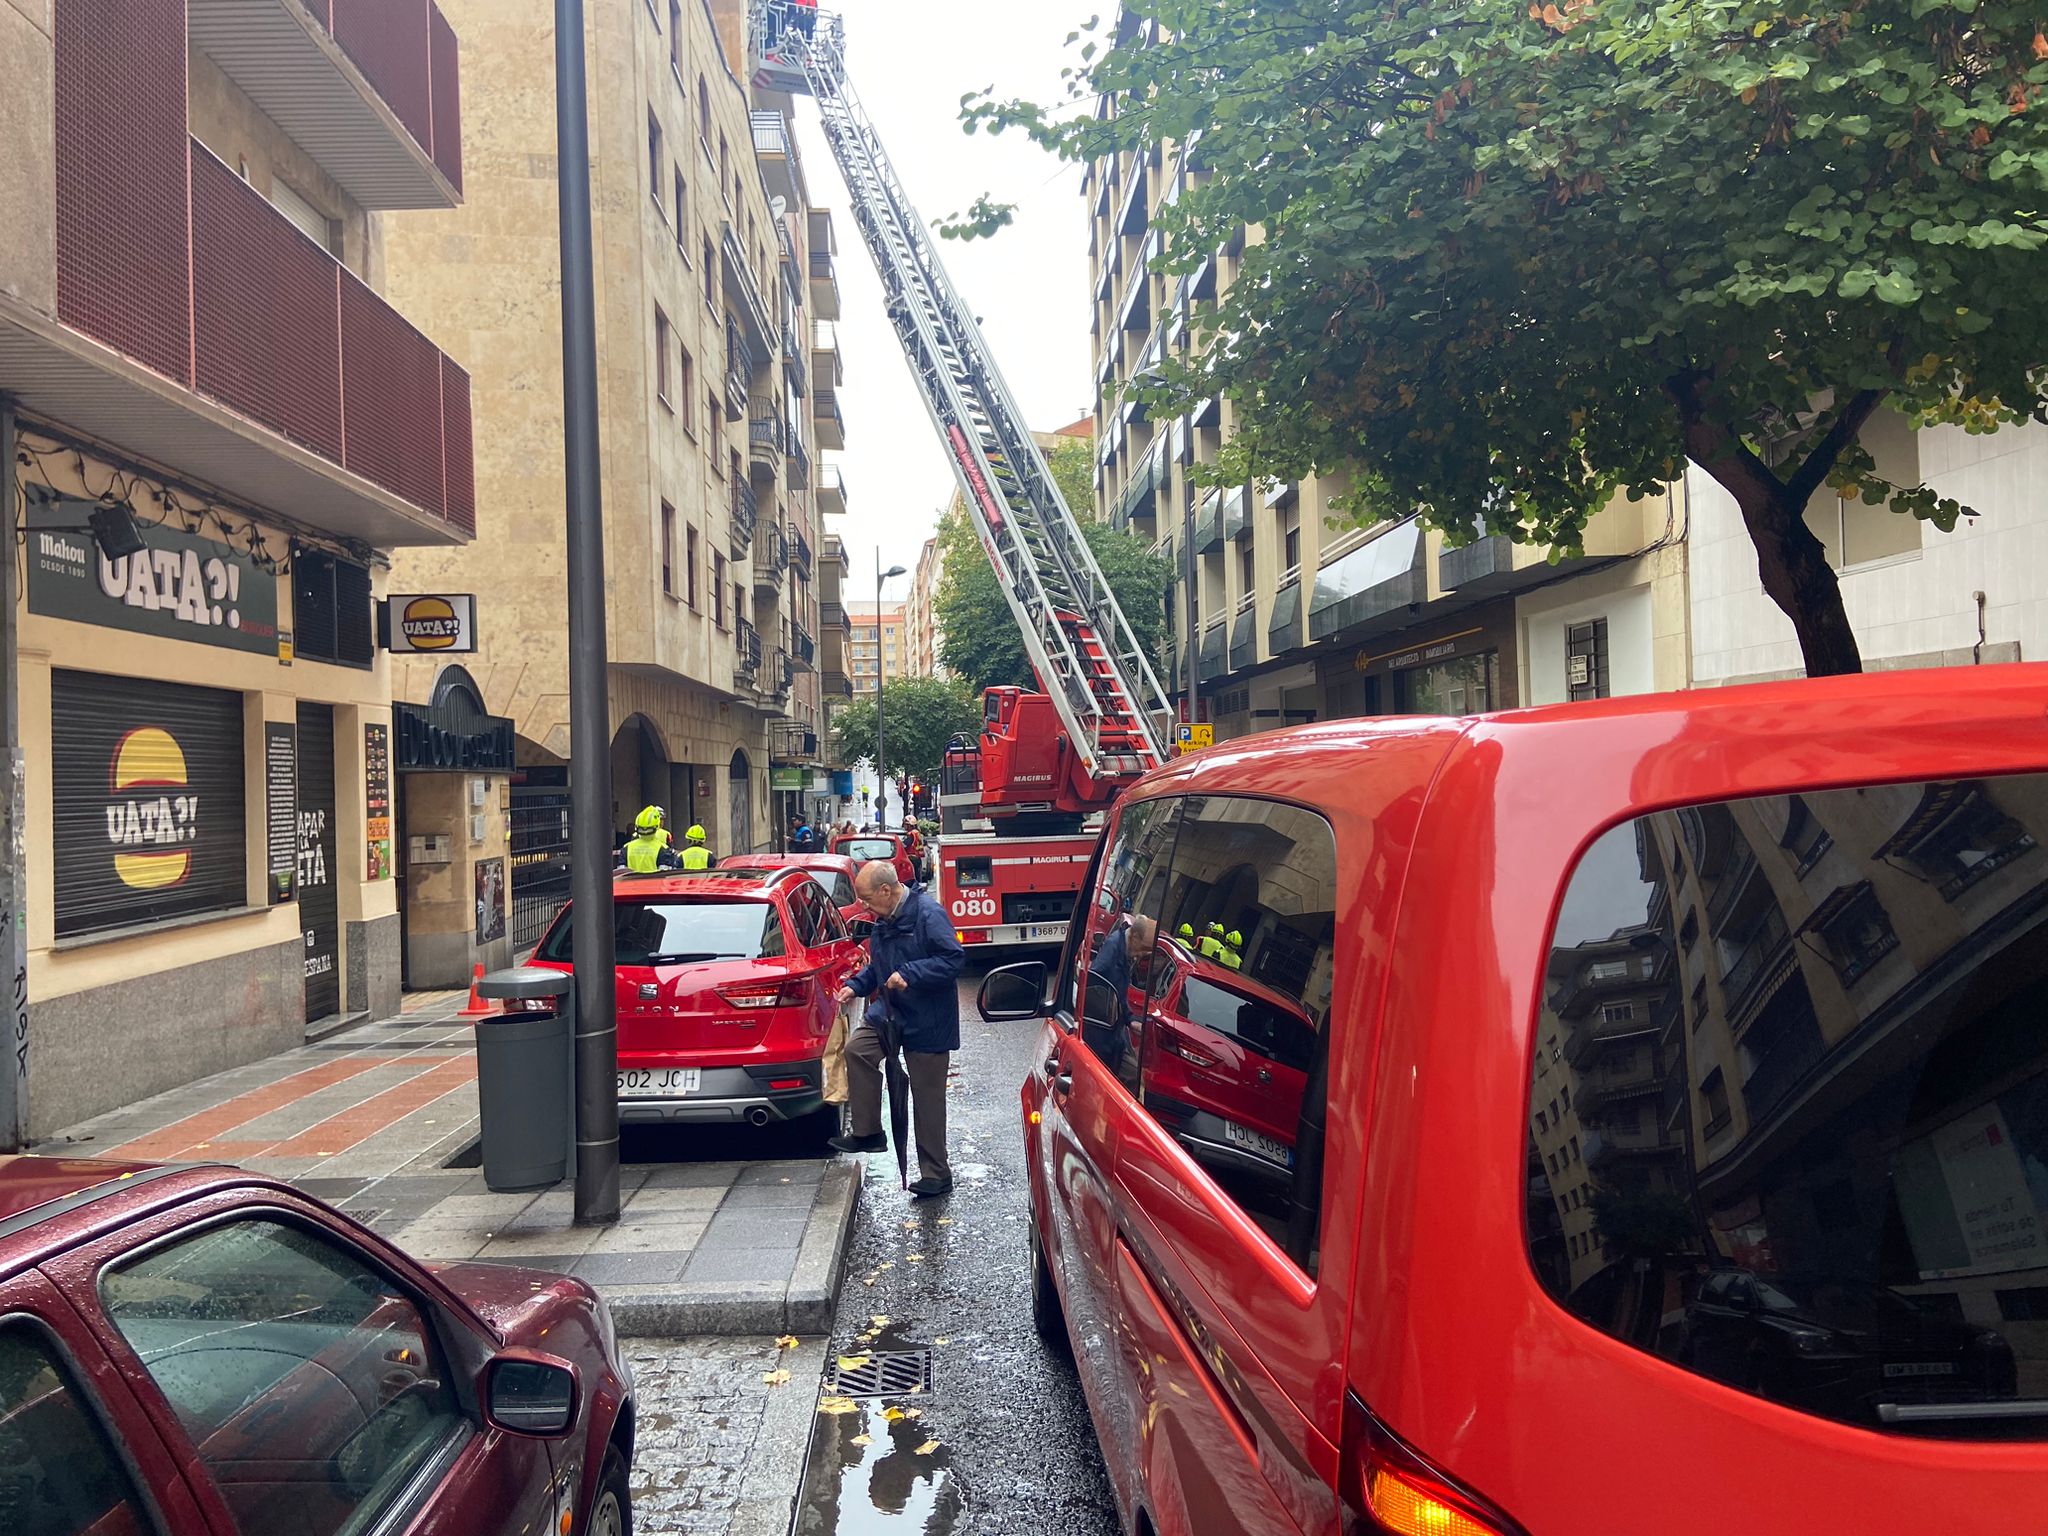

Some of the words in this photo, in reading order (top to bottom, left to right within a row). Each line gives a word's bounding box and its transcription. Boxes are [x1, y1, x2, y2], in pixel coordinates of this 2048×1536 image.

[40, 533, 86, 564] Mahou
[41, 560, 65, 574] DESDE
[984, 536, 1005, 582] MAGIRUS
[402, 620, 460, 636] UATA?!
[1013, 774, 1052, 783] MAGIRUS
[106, 796, 198, 844] UATA?!
[1032, 855, 1071, 864] MAGIRUS
[960, 888, 989, 899] Telf.
[951, 898, 996, 918] 080
[1037, 926, 1059, 936] 3687
[658, 1069, 696, 1089] JCH
